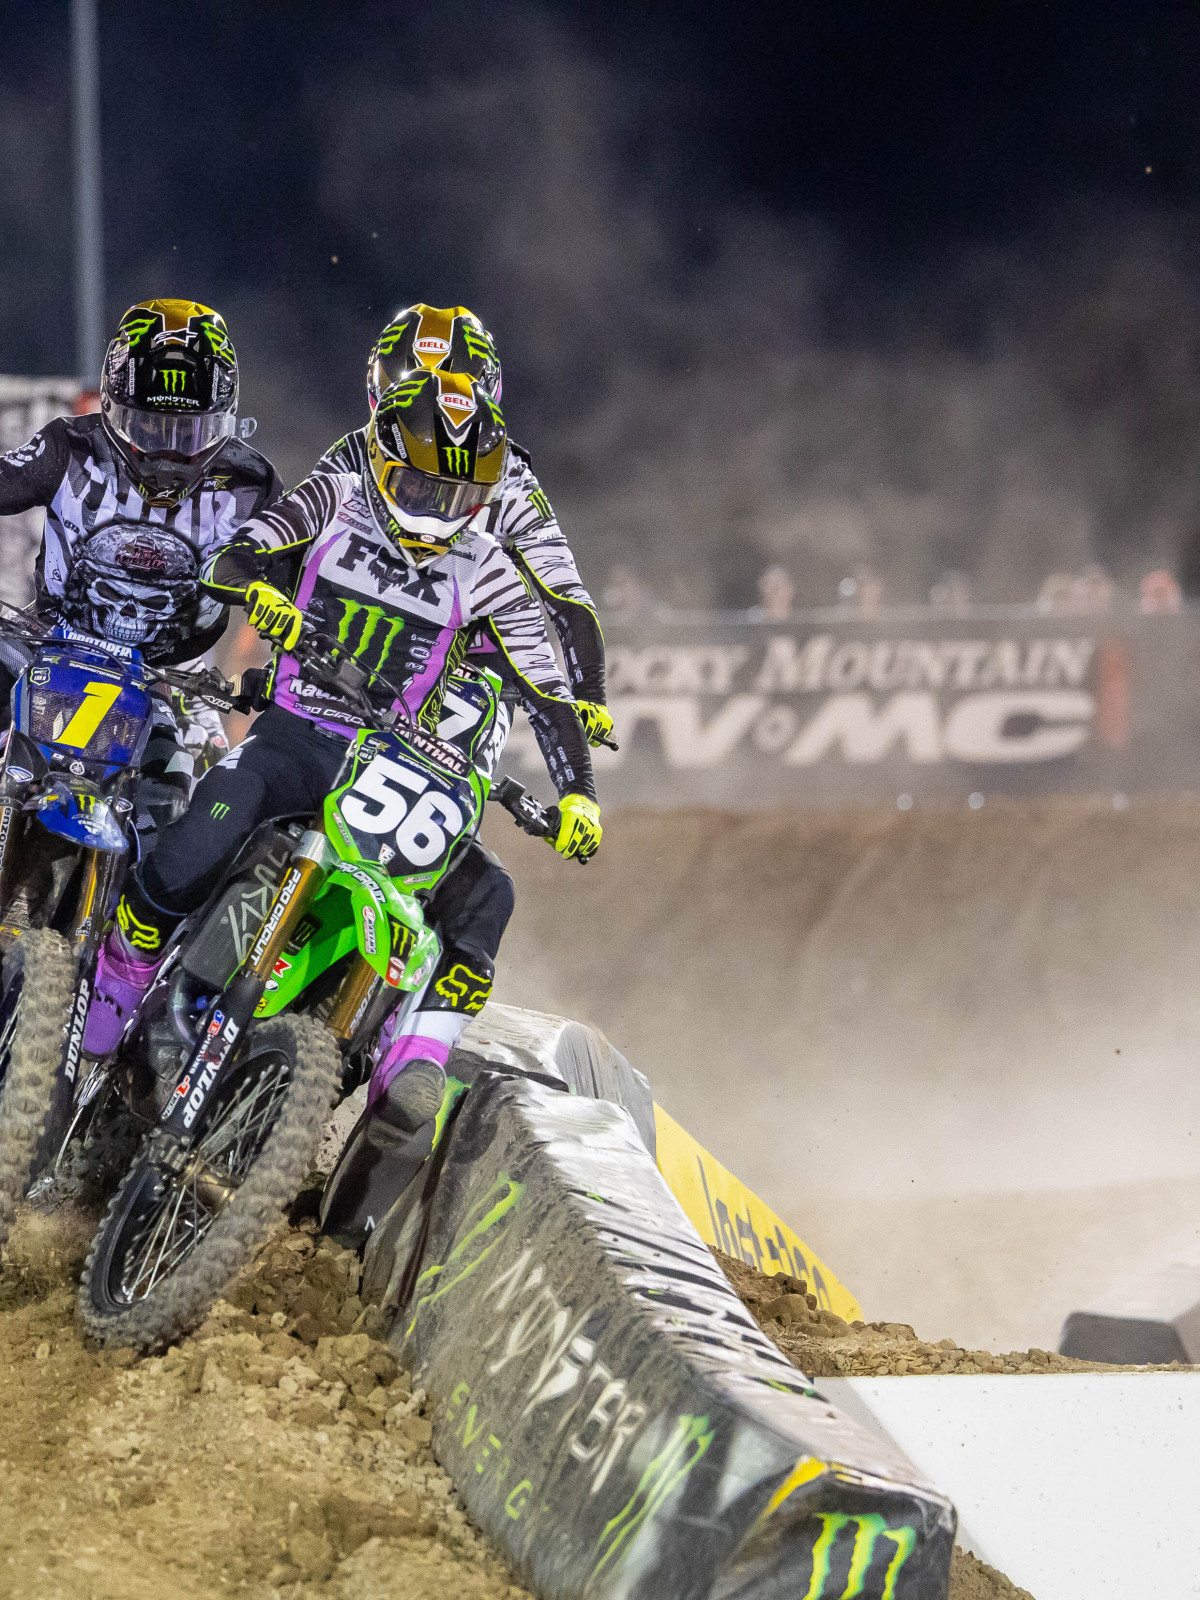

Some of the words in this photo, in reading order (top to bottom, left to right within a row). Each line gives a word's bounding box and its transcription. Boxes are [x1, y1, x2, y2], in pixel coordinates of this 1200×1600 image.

[419, 341, 446, 350] BELL
[146, 395, 200, 407] MONSTER
[443, 395, 472, 409] BELL
[69, 662, 121, 680] SUPERMOTOCROSS
[755, 635, 1098, 692] MOUNTAIN
[53, 681, 123, 749] 1
[397, 754, 452, 791] SUPERMOTOCROSS
[340, 754, 463, 867] 56
[277, 868, 302, 906] PRO
[354, 867, 387, 904] CIRCUIT
[250, 903, 285, 967] CIRCUIT
[64, 978, 90, 1083] DUNLOP
